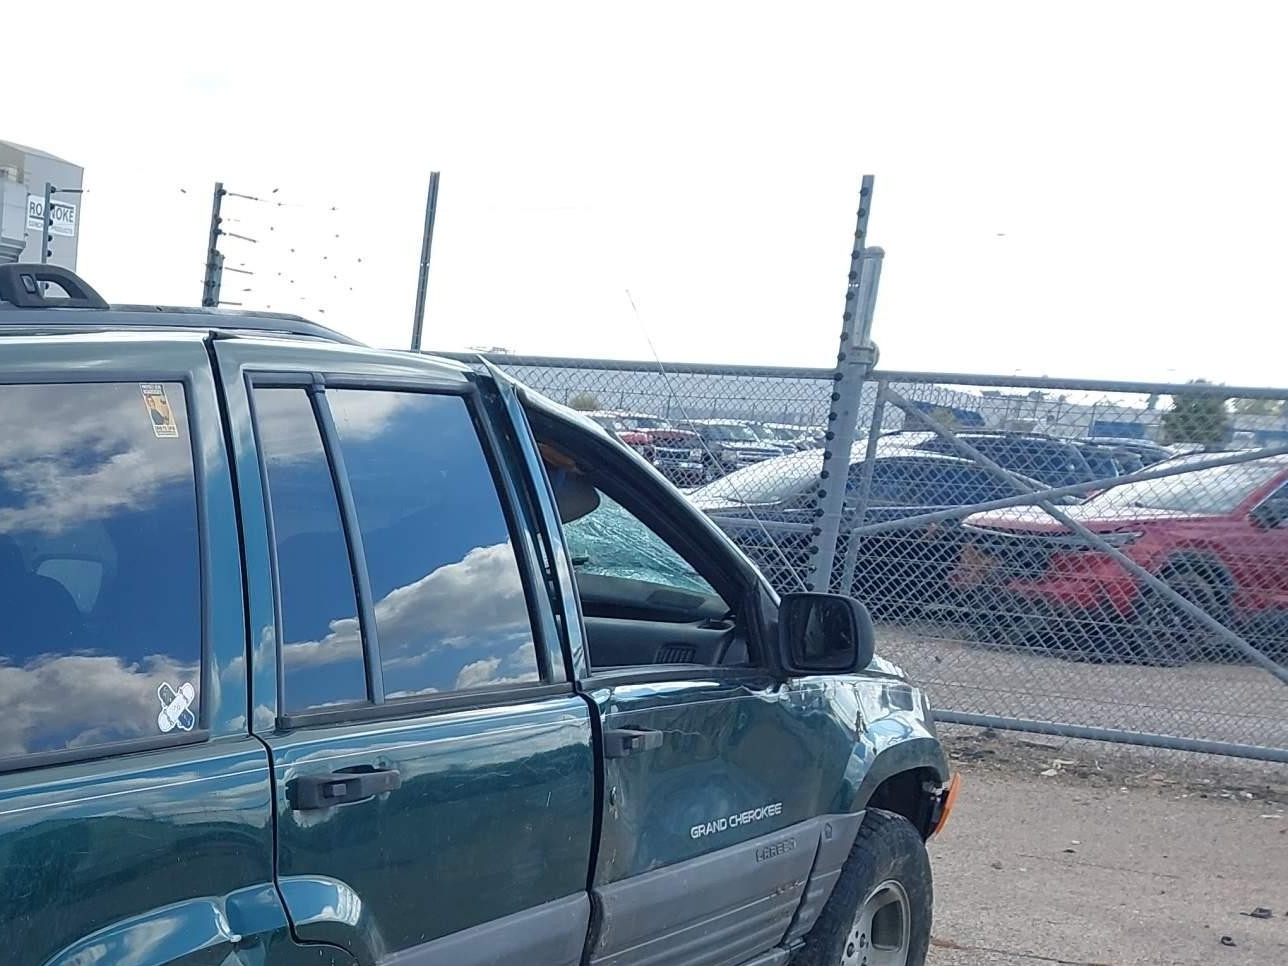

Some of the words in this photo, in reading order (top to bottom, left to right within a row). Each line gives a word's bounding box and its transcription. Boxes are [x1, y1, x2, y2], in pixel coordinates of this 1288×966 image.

[29, 201, 74, 223] ROOKE
[690, 818, 727, 839] GRAND
[728, 802, 783, 828] CHEROKEE
